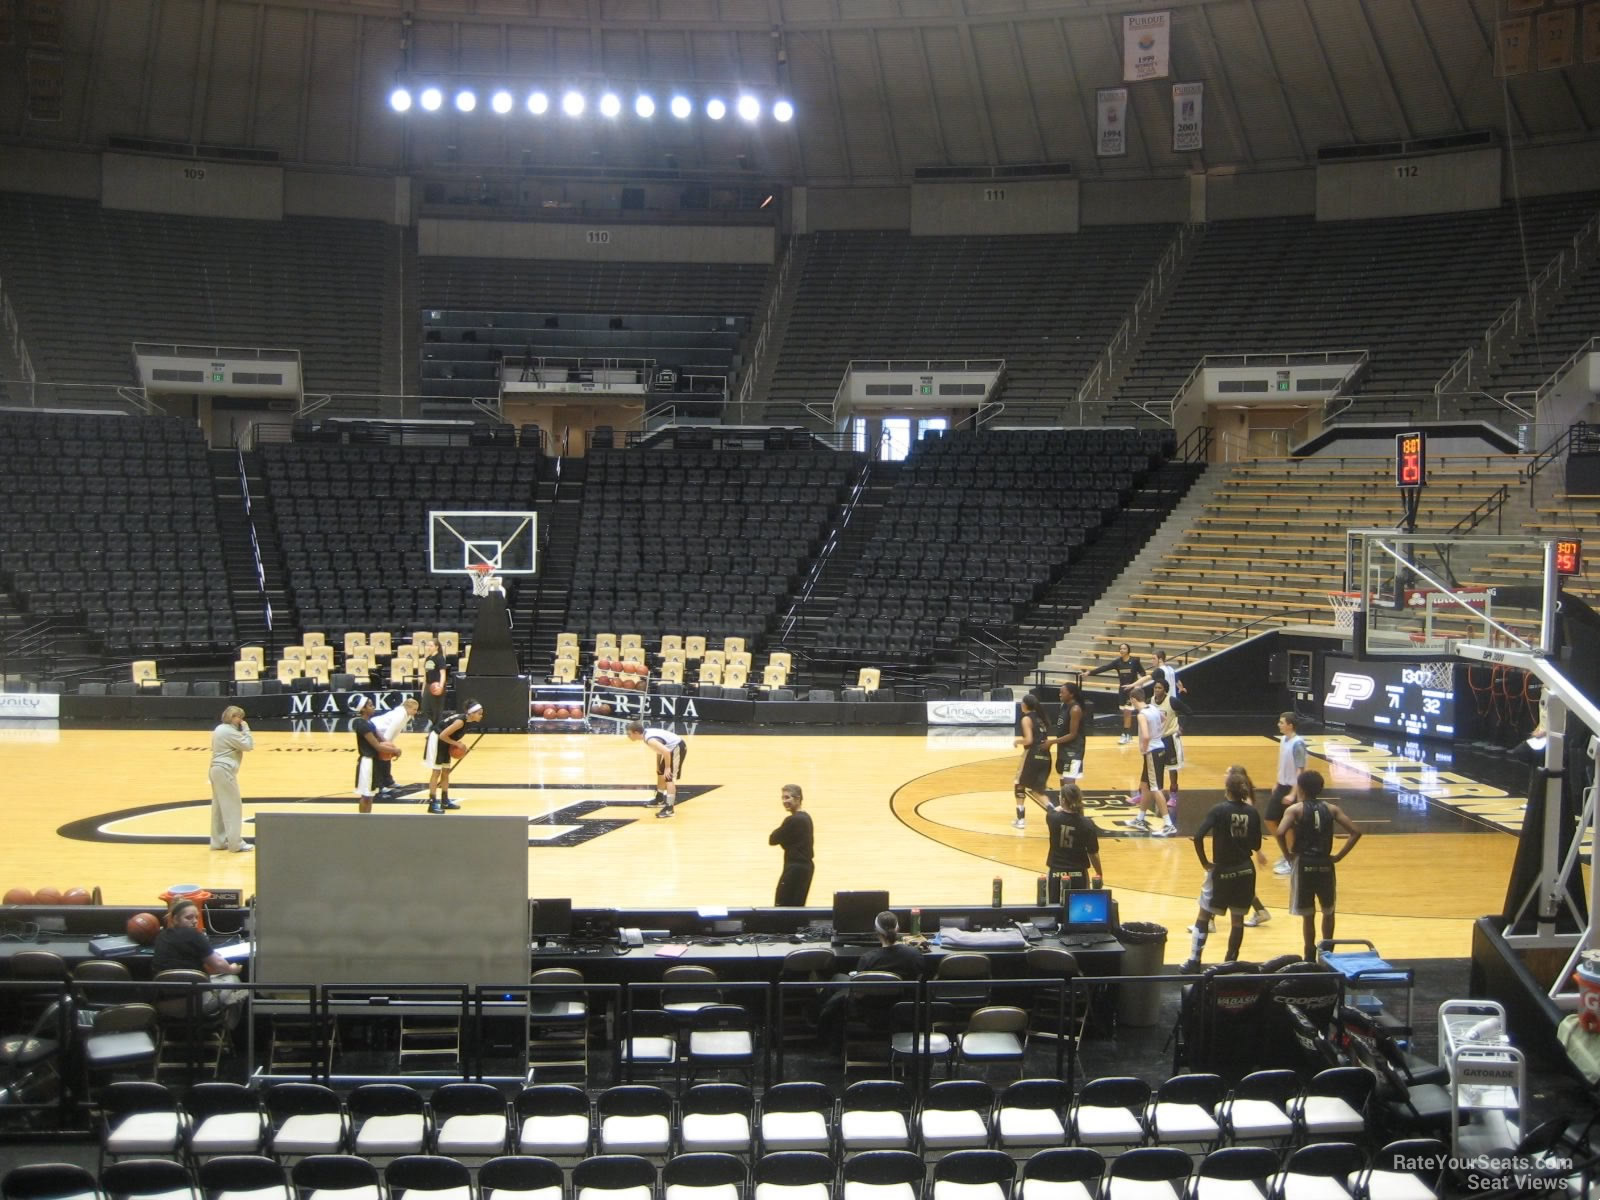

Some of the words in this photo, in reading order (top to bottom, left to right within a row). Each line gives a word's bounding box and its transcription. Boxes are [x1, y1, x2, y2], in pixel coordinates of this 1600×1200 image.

[1129, 16, 1164, 26] PURDUE
[1177, 123, 1198, 132] 2001
[1102, 130, 1121, 138] 1994
[184, 168, 205, 180] 109
[1397, 166, 1419, 178] 112
[986, 190, 1005, 201] 111
[588, 231, 609, 243] 110
[1557, 543, 1577, 554] 3:07
[1324, 672, 1375, 710] P
[1387, 693, 1400, 709] 71
[1422, 698, 1441, 715] 32
[1059, 824, 1076, 848] 15
[1463, 1068, 1515, 1079] GATORADE
